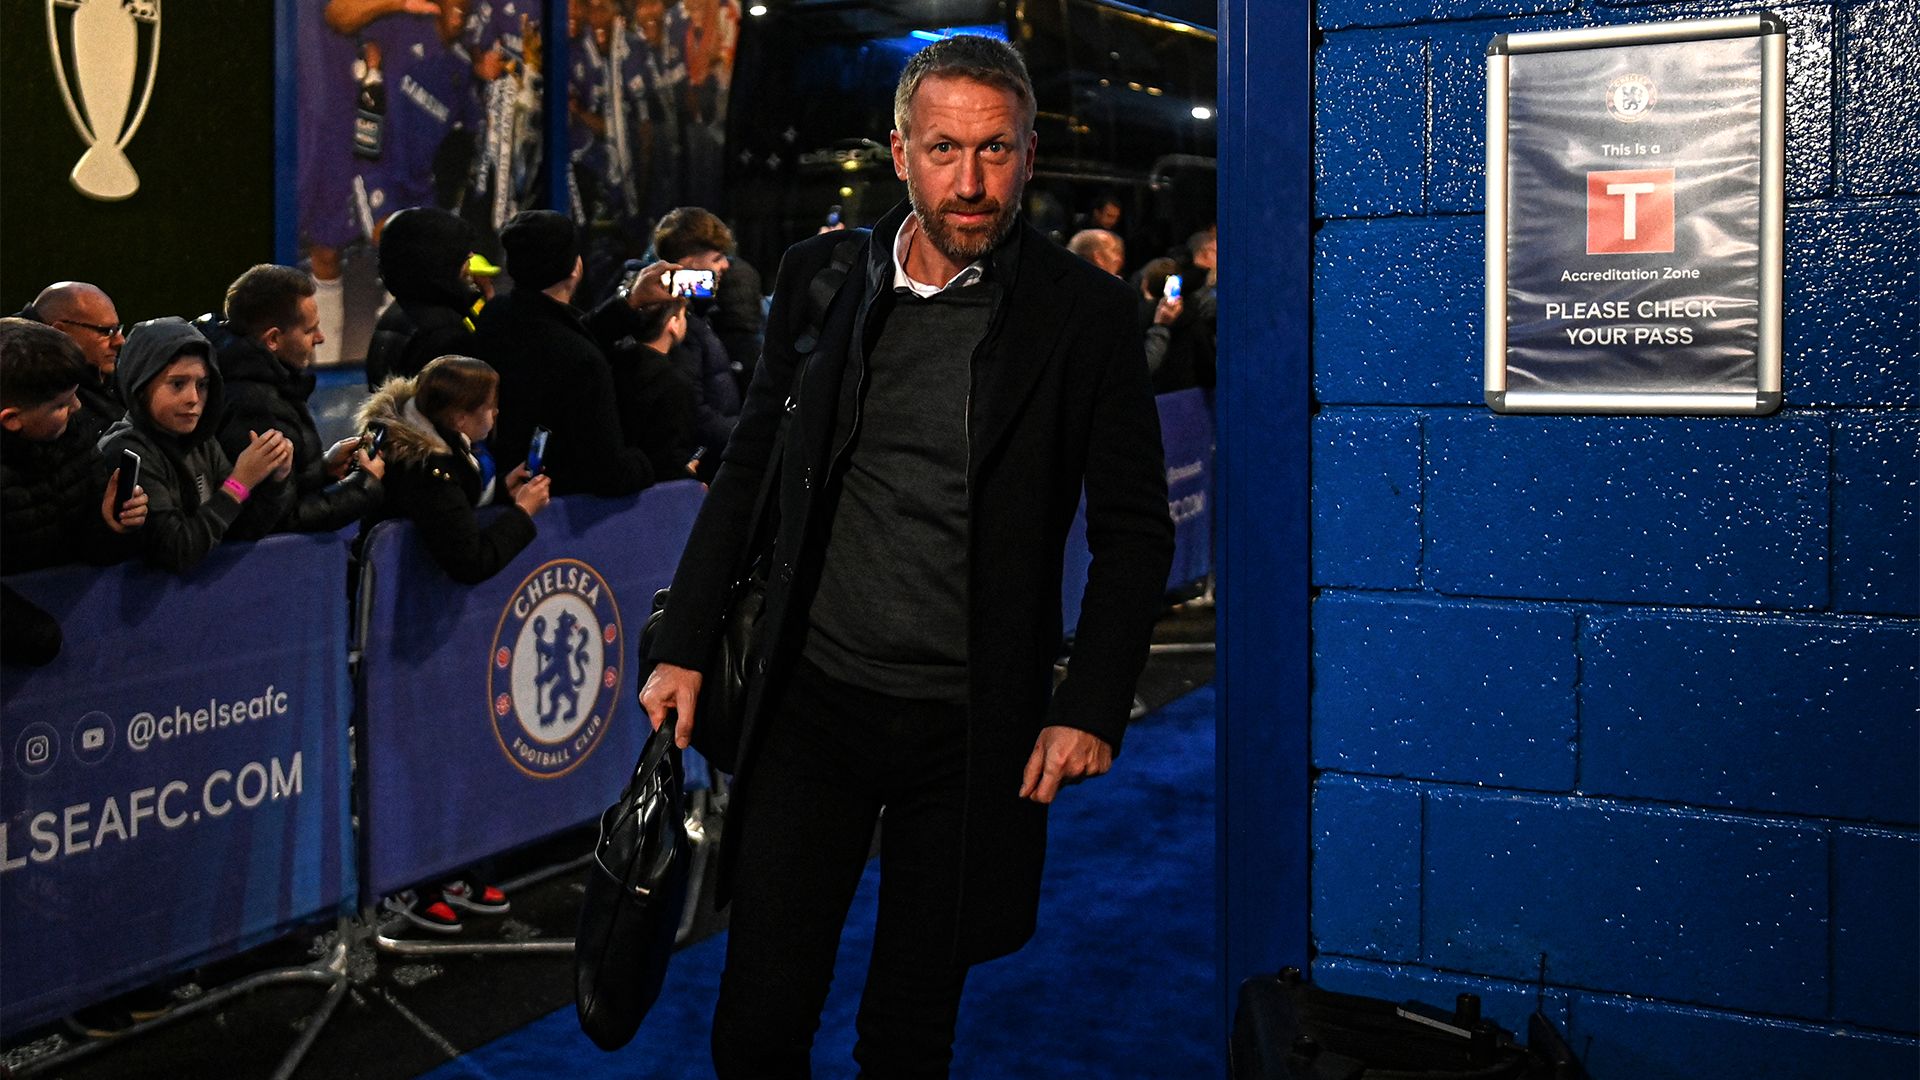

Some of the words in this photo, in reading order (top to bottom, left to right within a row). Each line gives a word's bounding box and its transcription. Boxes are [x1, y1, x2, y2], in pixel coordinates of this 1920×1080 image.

[1602, 143, 1631, 156] This
[1650, 144, 1660, 154] a
[1606, 182, 1655, 240] T
[1560, 268, 1659, 282] Accreditation
[1663, 267, 1700, 280] Zone
[1546, 301, 1630, 320] PLEASE
[1637, 300, 1717, 319] CHECK
[1566, 328, 1627, 345] YOUR
[1634, 327, 1694, 345] PASS
[513, 567, 600, 619] CHELSEA
[127, 684, 288, 750] @chelseafc
[513, 736, 571, 766] FOOTBALL
[574, 714, 601, 752] CLUB
[0, 751, 303, 872] LSEAFC.COM
